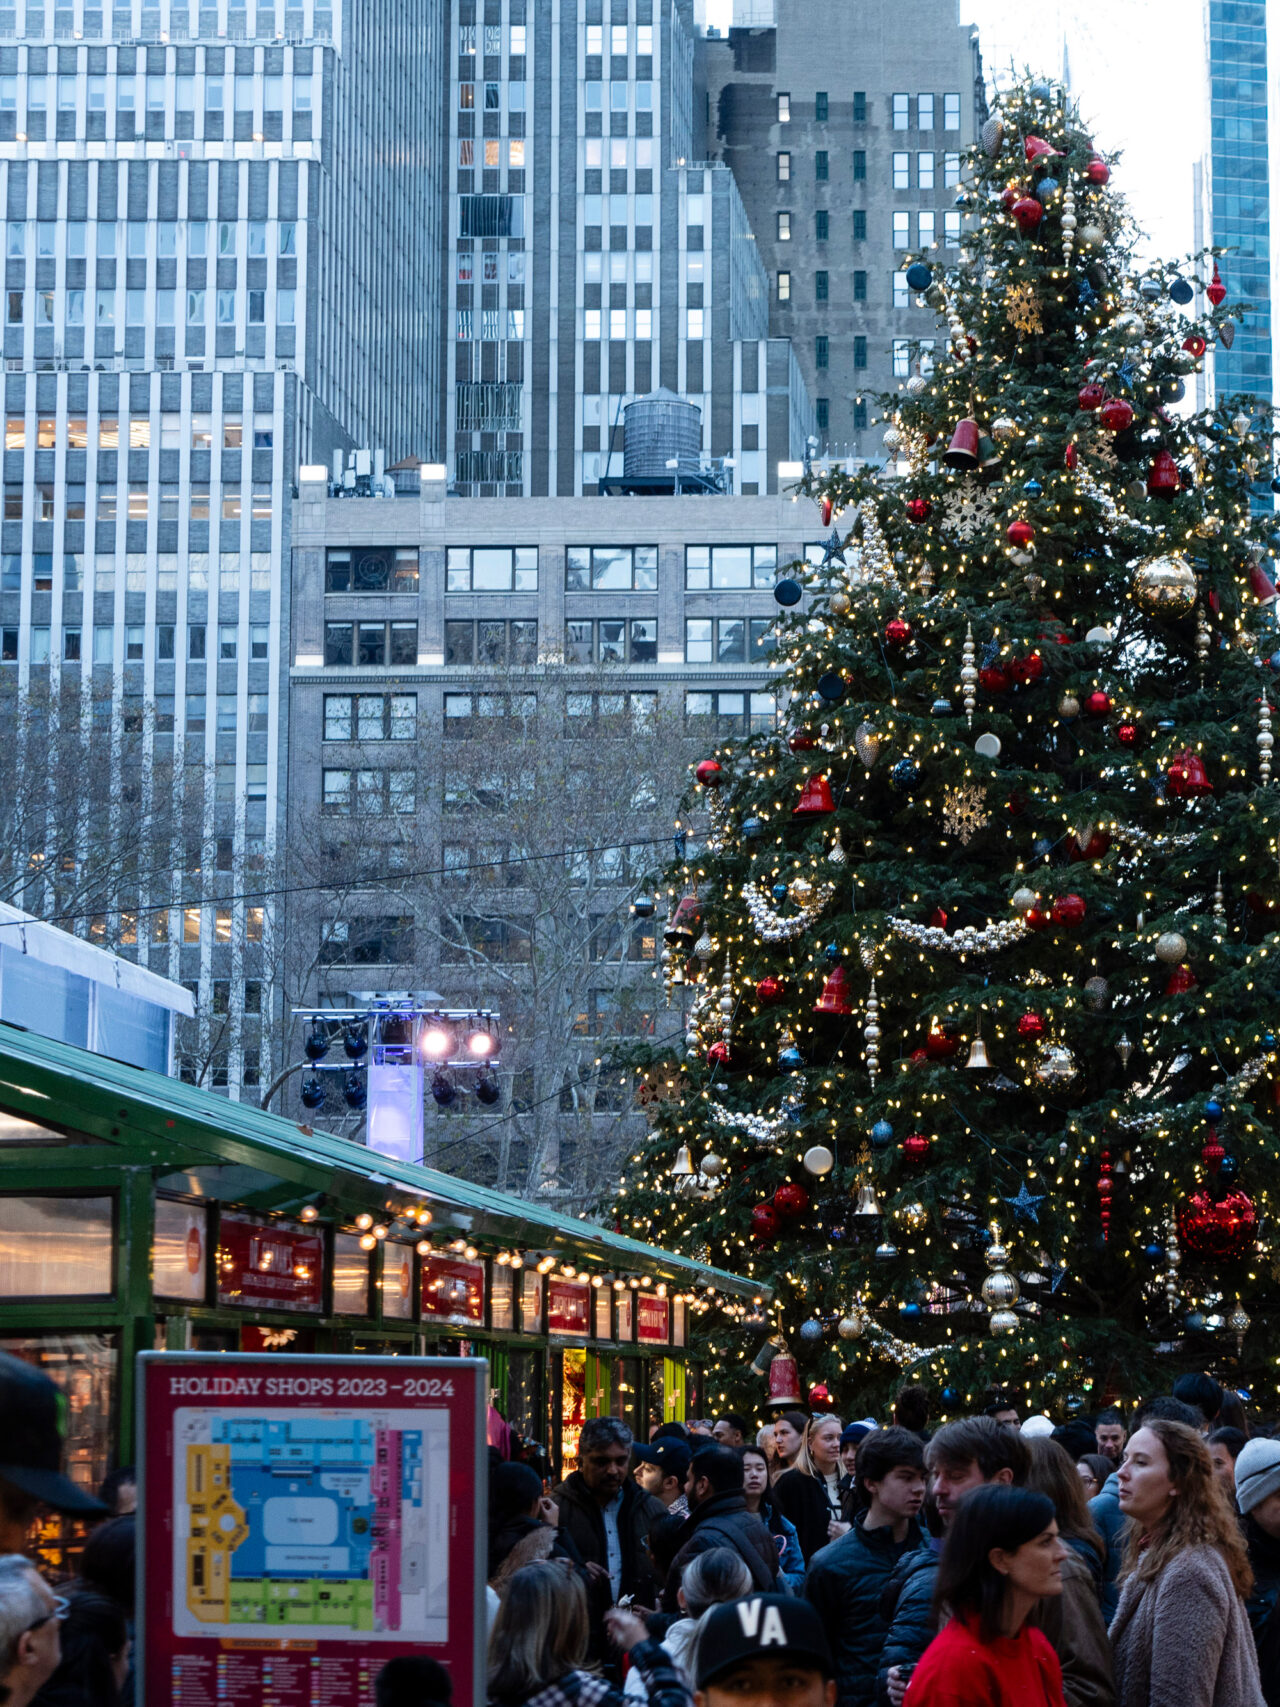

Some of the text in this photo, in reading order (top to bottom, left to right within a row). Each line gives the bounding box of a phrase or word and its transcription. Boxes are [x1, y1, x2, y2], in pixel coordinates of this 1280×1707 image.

[169, 1377, 262, 1395] HOLIDAY
[265, 1378, 334, 1396] SHOPS
[736, 1597, 788, 1646] VA
